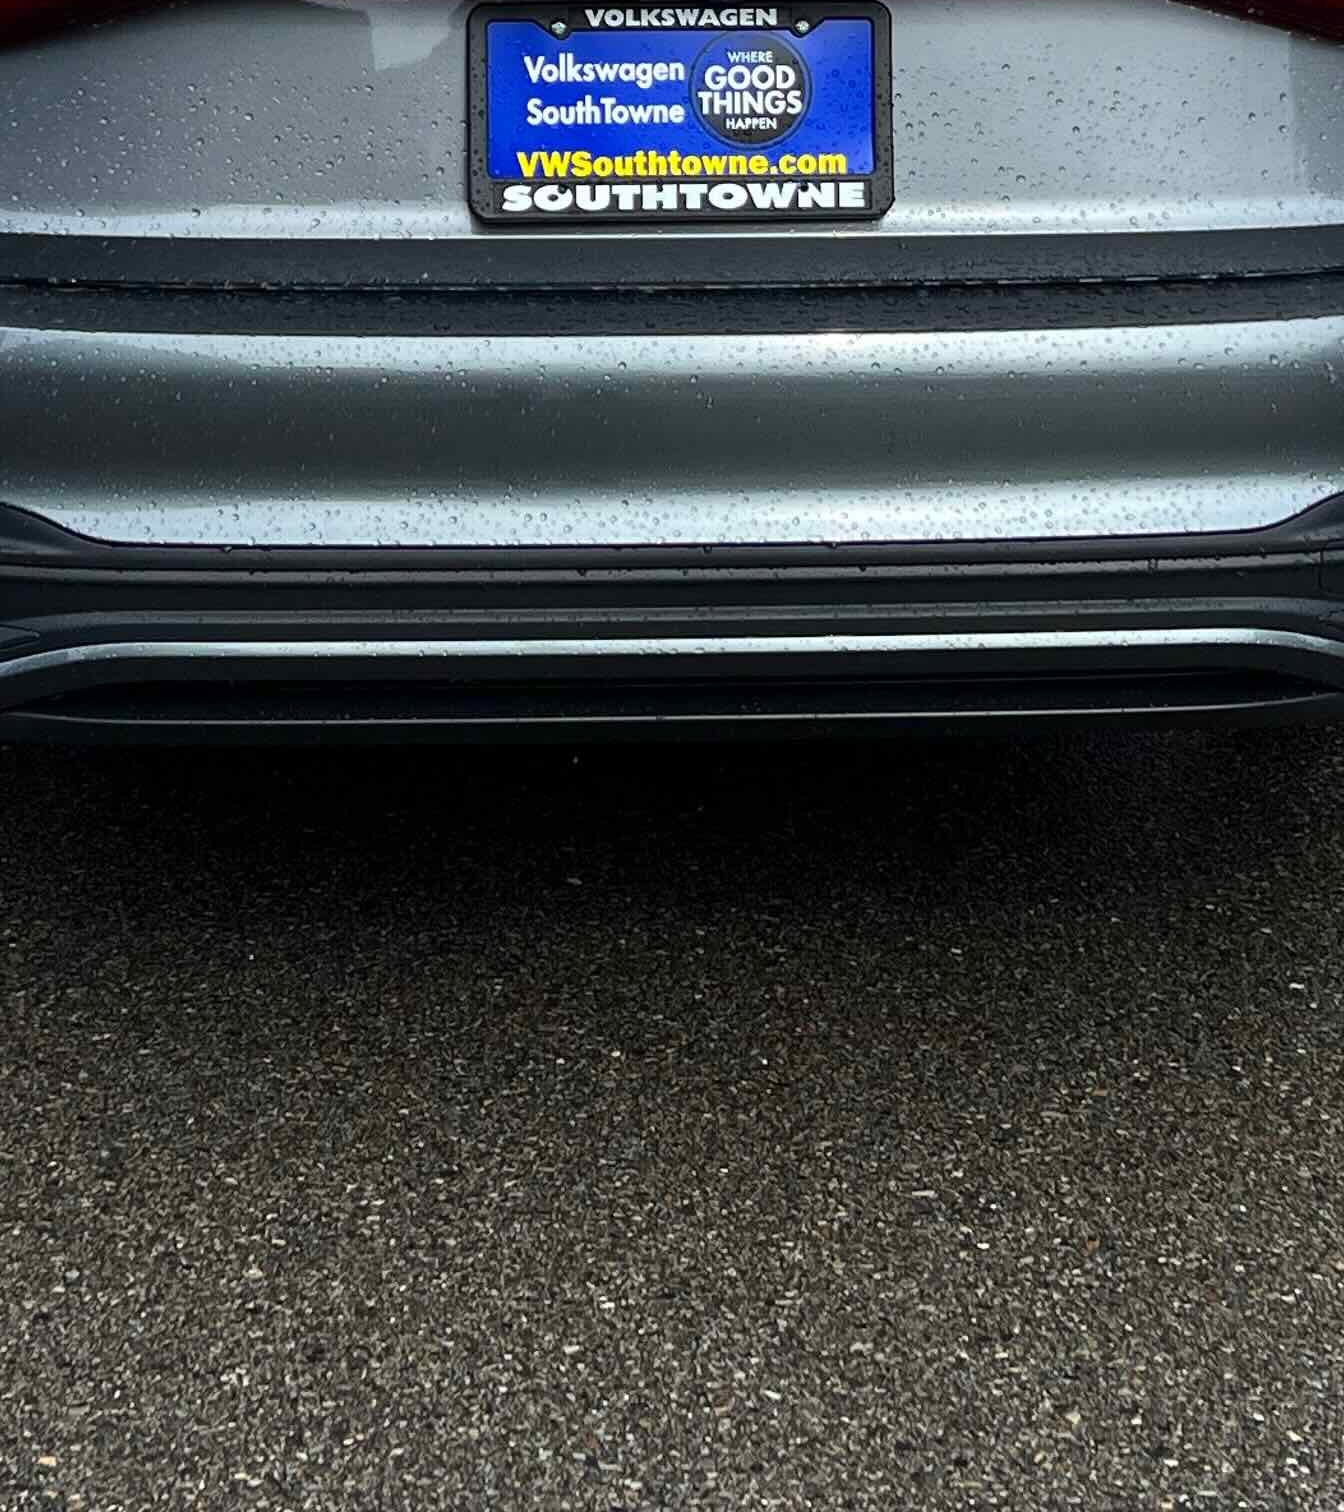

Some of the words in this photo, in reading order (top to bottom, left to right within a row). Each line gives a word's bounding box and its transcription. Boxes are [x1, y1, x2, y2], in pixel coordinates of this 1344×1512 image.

[584, 8, 778, 28] VOLKSWAGEN
[726, 50, 774, 64] WHERE
[523, 52, 686, 89] Volkswagen
[703, 65, 796, 91] GOOD
[526, 95, 686, 126] SouthTowne
[697, 90, 803, 116] THINGS
[725, 117, 777, 130] HAPPEN
[516, 150, 848, 178] VWSouthtowne.com
[501, 182, 866, 212] SOUTHTOWNE
